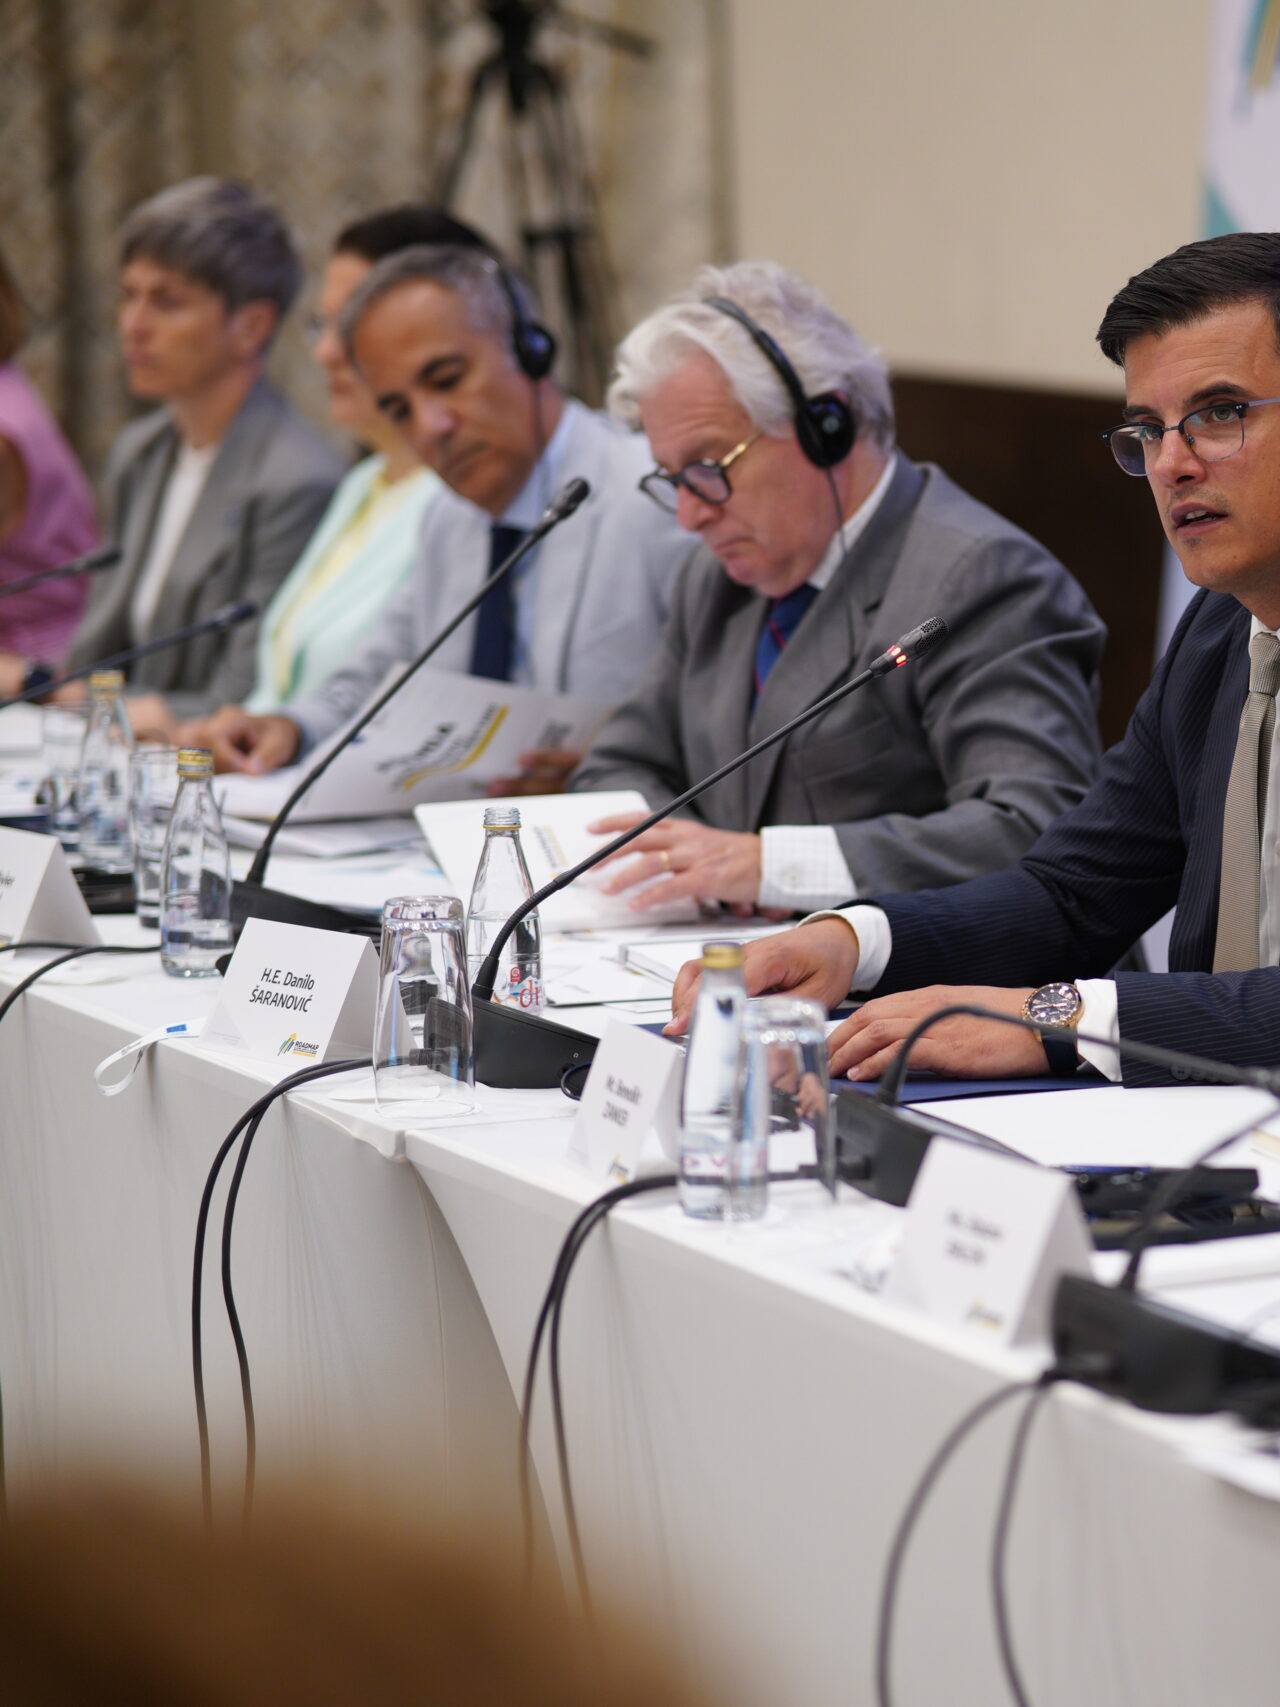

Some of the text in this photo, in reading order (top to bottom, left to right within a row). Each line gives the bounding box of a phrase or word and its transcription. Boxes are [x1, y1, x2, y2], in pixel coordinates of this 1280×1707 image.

[260, 967, 315, 990] H.E. Danilo
[248, 985, 313, 1013] ŠARANOVIĆ
